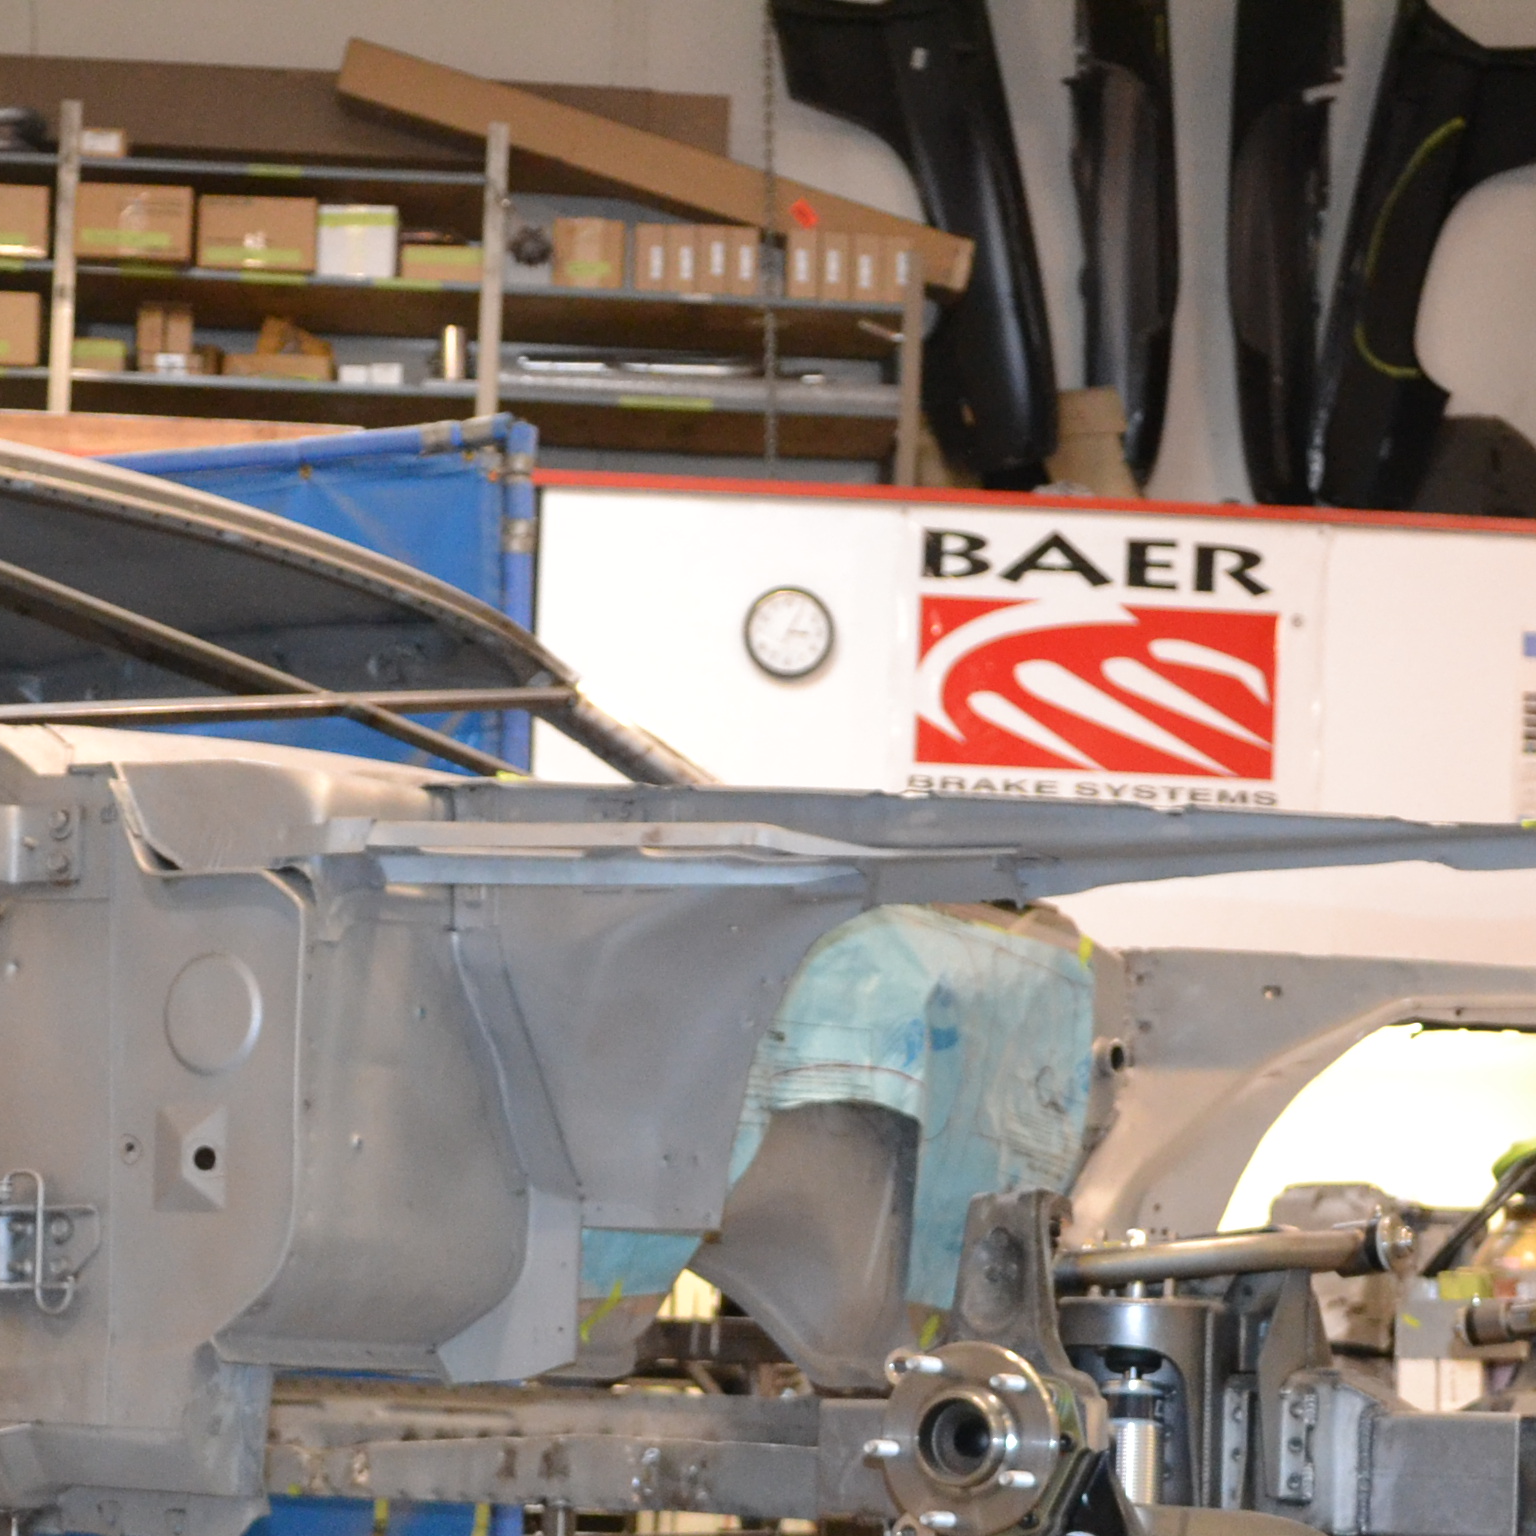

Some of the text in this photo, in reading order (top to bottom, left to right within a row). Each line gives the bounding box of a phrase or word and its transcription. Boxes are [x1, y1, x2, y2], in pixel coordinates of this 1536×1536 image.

[921, 527, 1272, 598] BAER
[907, 774, 1278, 807] BRAKE SYSTEMS
